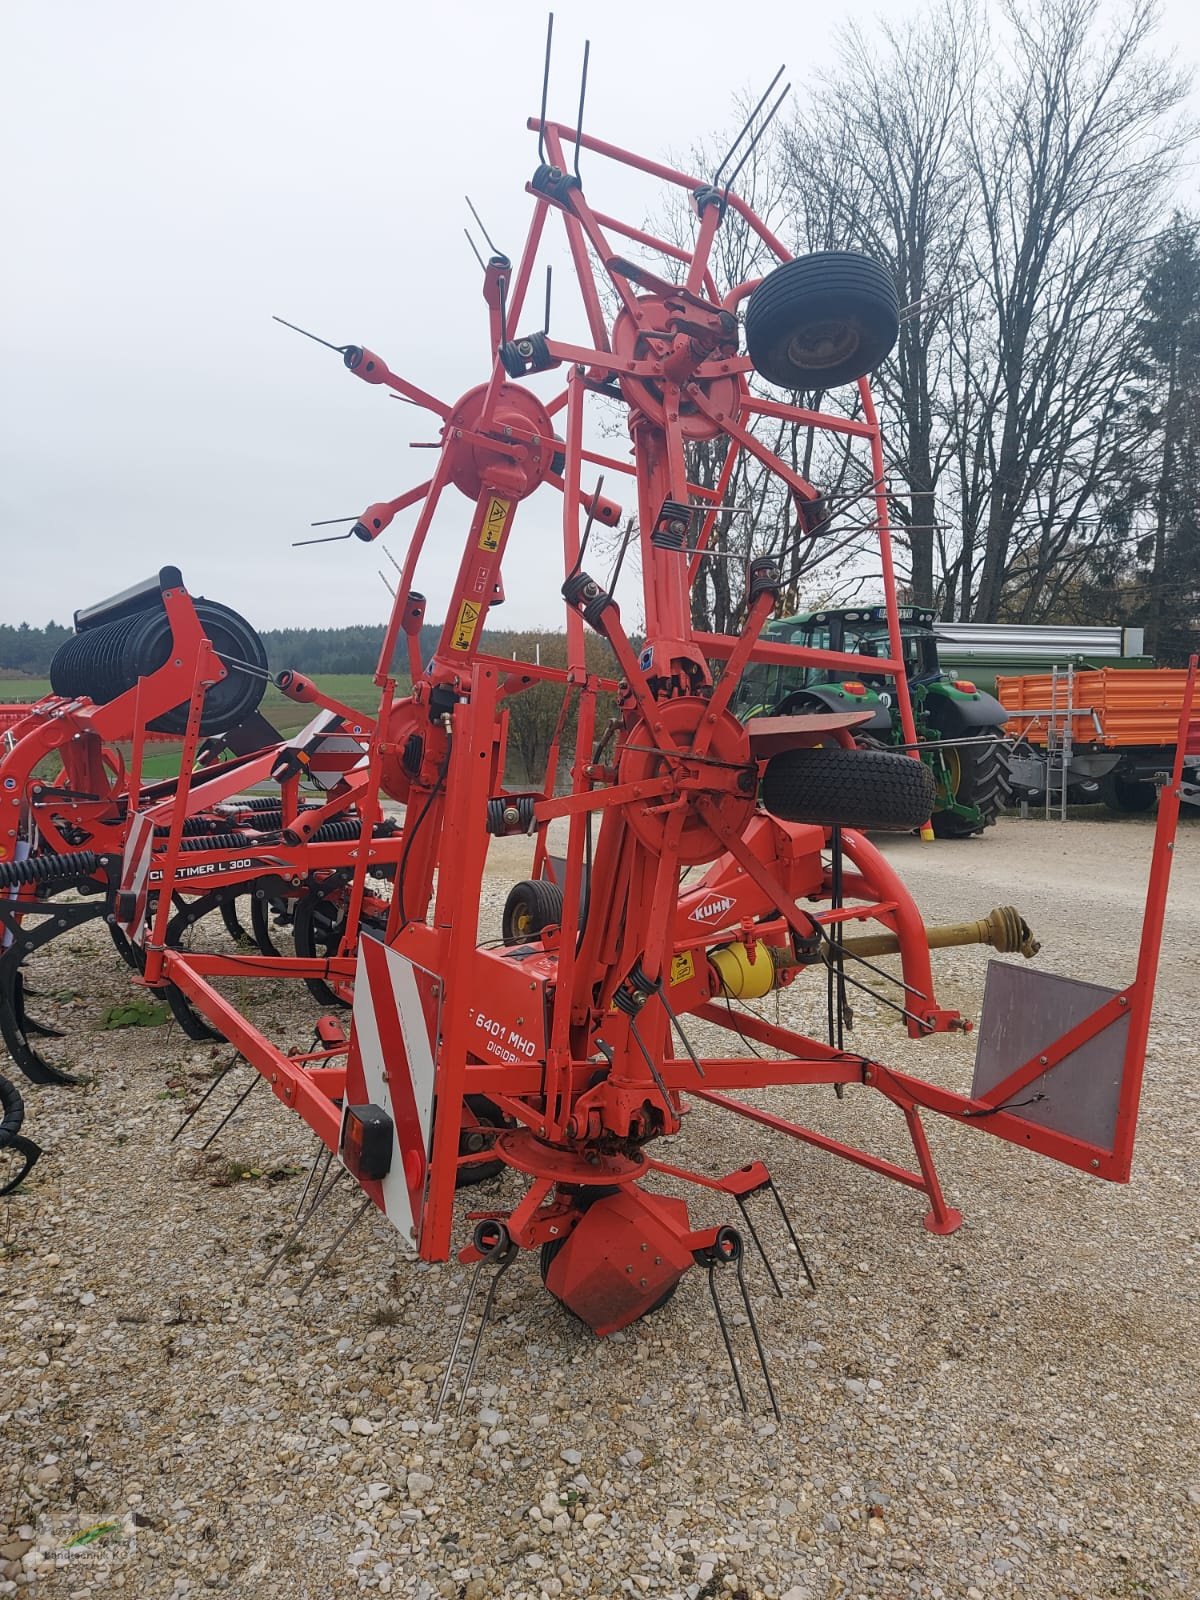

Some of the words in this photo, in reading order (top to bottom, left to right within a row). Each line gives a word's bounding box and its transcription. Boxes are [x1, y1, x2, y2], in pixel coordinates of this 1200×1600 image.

[149, 864, 215, 880] CTIMER
[218, 863, 226, 871] L
[229, 858, 252, 870] 300
[695, 898, 730, 920] KUHN
[475, 1013, 506, 1040] 6401
[507, 1031, 536, 1057] MHO
